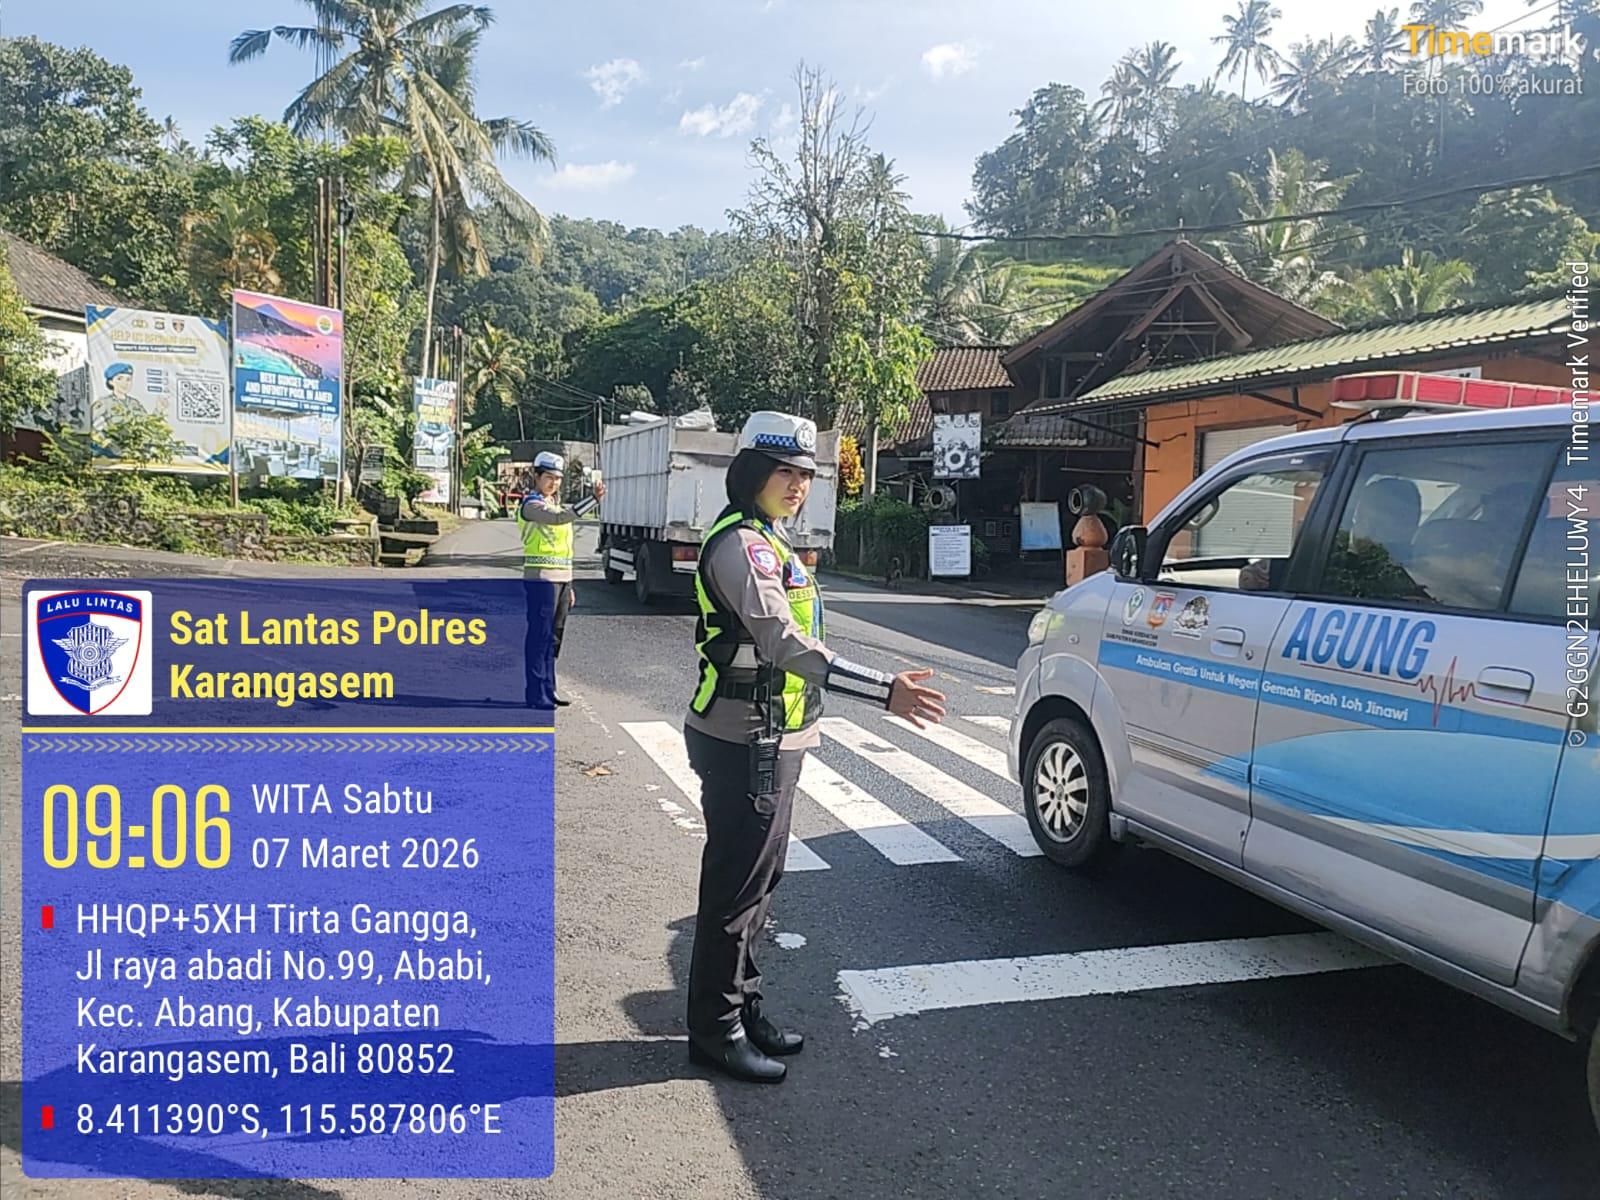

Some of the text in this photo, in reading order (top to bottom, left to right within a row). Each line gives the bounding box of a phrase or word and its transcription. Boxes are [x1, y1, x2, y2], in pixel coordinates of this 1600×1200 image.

[1281, 607, 1437, 680] AGUNG
[1136, 654, 1409, 722] Ambulan Gratis Untuk Negeri Gemah Ripah Loh Jinawi
